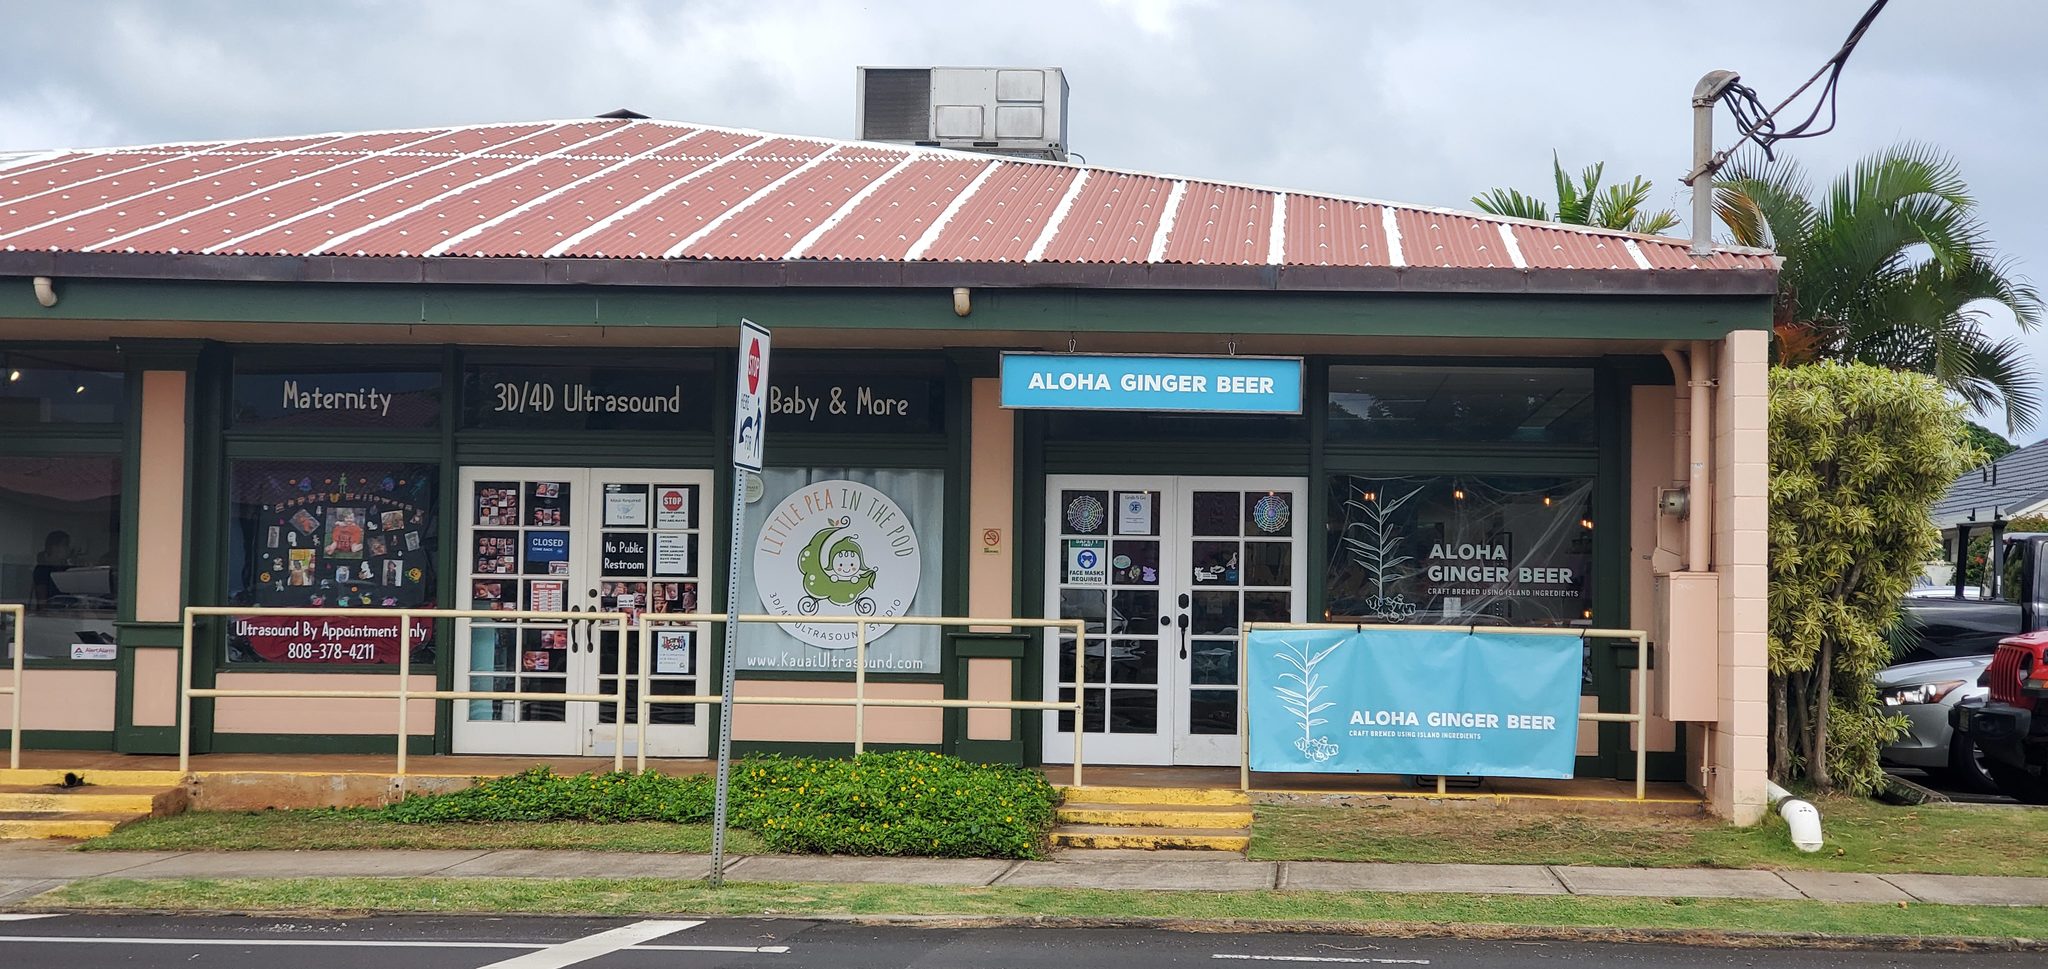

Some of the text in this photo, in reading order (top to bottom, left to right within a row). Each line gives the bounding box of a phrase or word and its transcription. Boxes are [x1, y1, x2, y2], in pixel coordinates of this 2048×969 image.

[748, 354, 760, 378] STOP
[1028, 372, 1275, 394] ALOHA GINGER BEER
[283, 380, 392, 417] Maternity
[494, 381, 680, 413] 3D/4D Ultrasound
[770, 385, 909, 421] Baby & More
[663, 496, 682, 505] STOP
[760, 488, 914, 558] LITTLE PEA IN THE POD
[532, 538, 564, 547] CLOSED
[605, 541, 644, 554] No Public
[1428, 543, 1508, 560] ALOHA
[604, 557, 645, 570] Restroom
[1427, 565, 1573, 584] GINGER BEER
[1427, 587, 1450, 595] CRAFT
[1505, 589, 1531, 597] ISLAND
[1532, 589, 1579, 597] INGREDIENTS
[769, 592, 791, 617] 3D/4
[795, 621, 862, 641] ULTRASOUN
[235, 620, 427, 641] Ultrasound By Appointment nly
[287, 643, 374, 660] 808-378-4211
[1349, 710, 1556, 730] ALOHA GINGER BEER
[1441, 732, 1481, 740] INGREDIENTS
